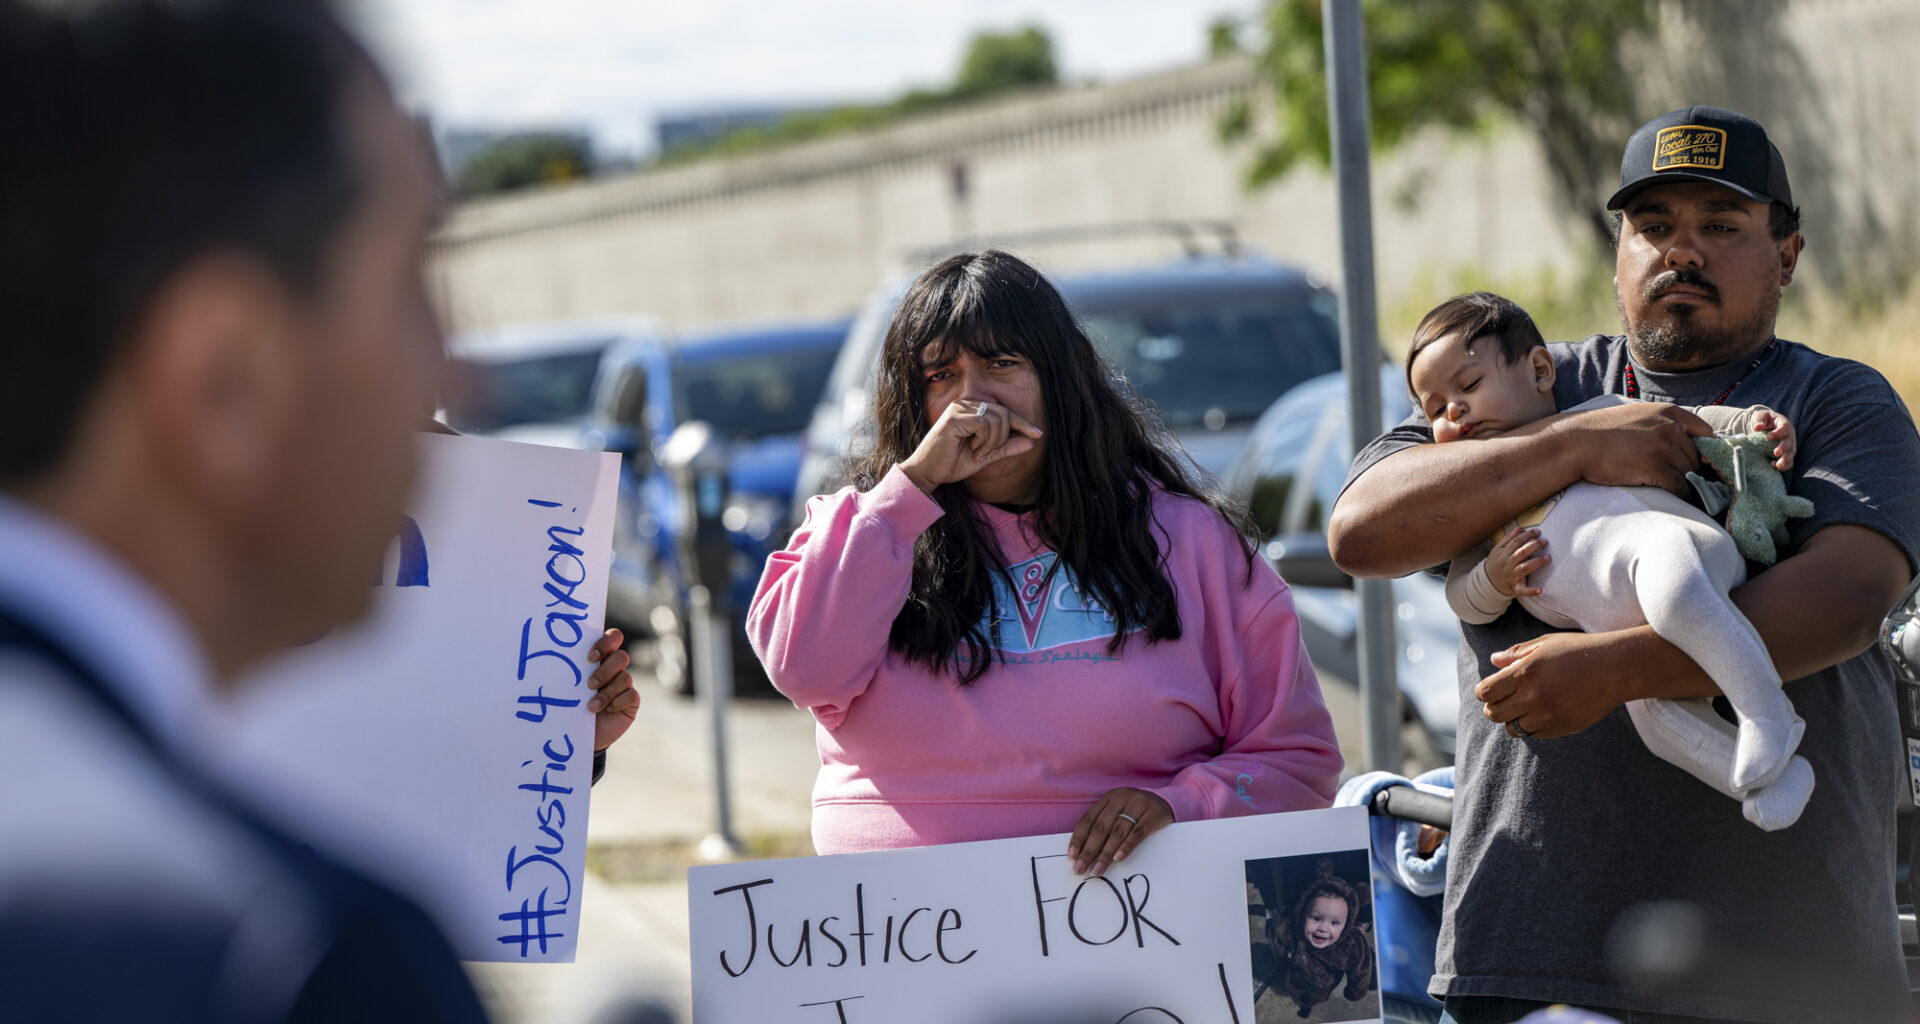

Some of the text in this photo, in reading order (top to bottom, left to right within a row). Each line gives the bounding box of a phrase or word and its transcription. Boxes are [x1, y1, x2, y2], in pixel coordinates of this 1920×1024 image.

[1660, 132, 1716, 154] Local 270
[1670, 156, 1716, 165] EST. 1916
[515, 686, 581, 723] 4
[713, 854, 1181, 978] Justice FOR
